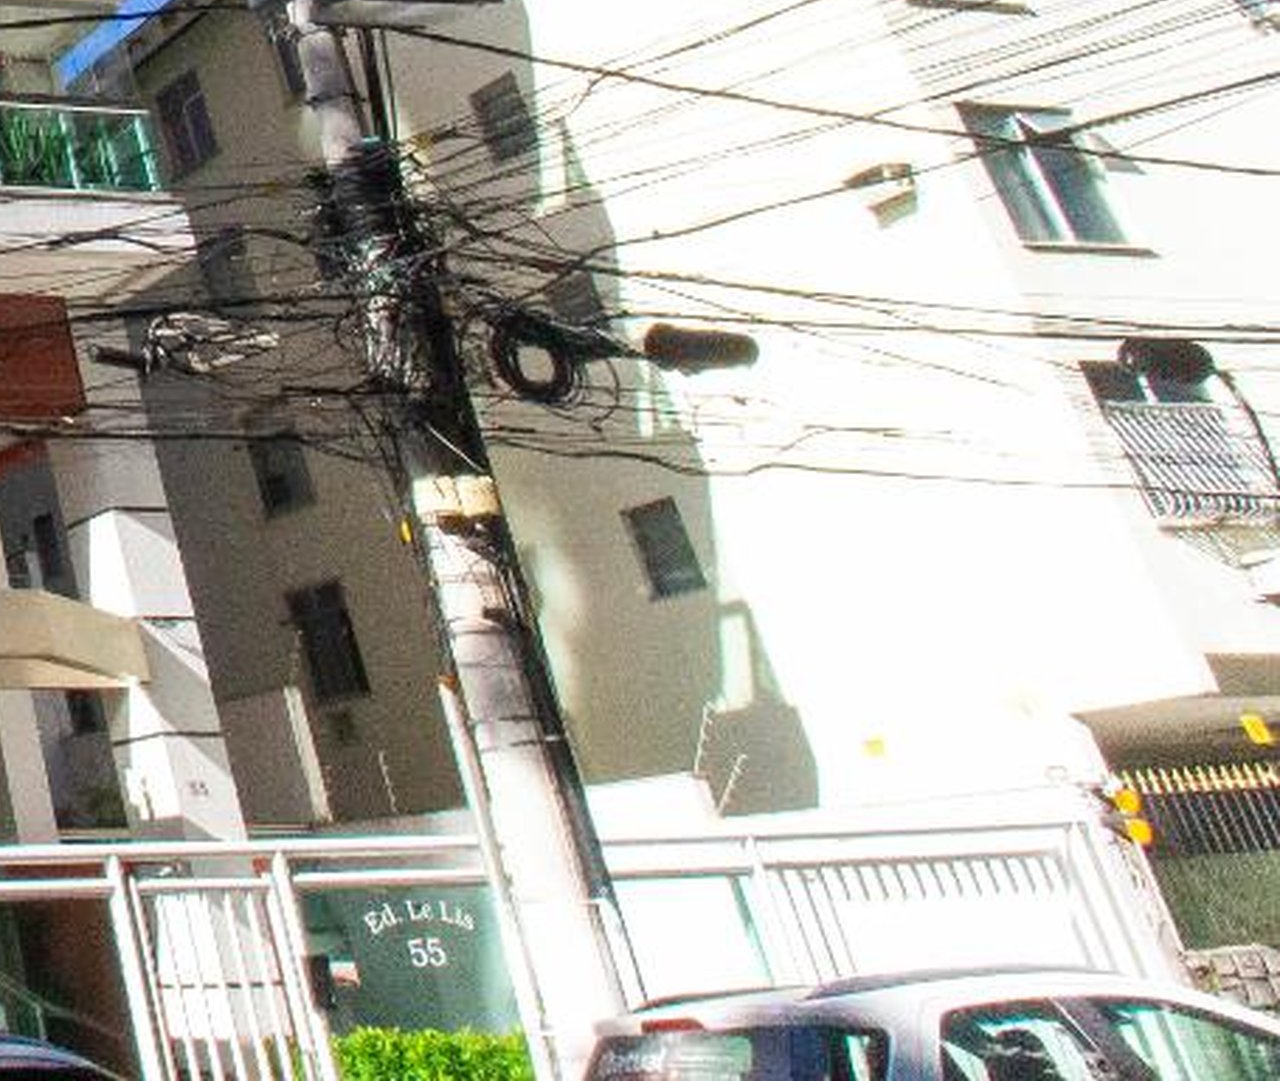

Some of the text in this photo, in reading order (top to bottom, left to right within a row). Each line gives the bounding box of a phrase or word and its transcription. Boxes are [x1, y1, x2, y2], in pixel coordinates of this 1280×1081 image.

[365, 904, 403, 934] Ed.
[440, 901, 474, 930] Lis
[407, 938, 447, 968] 55
